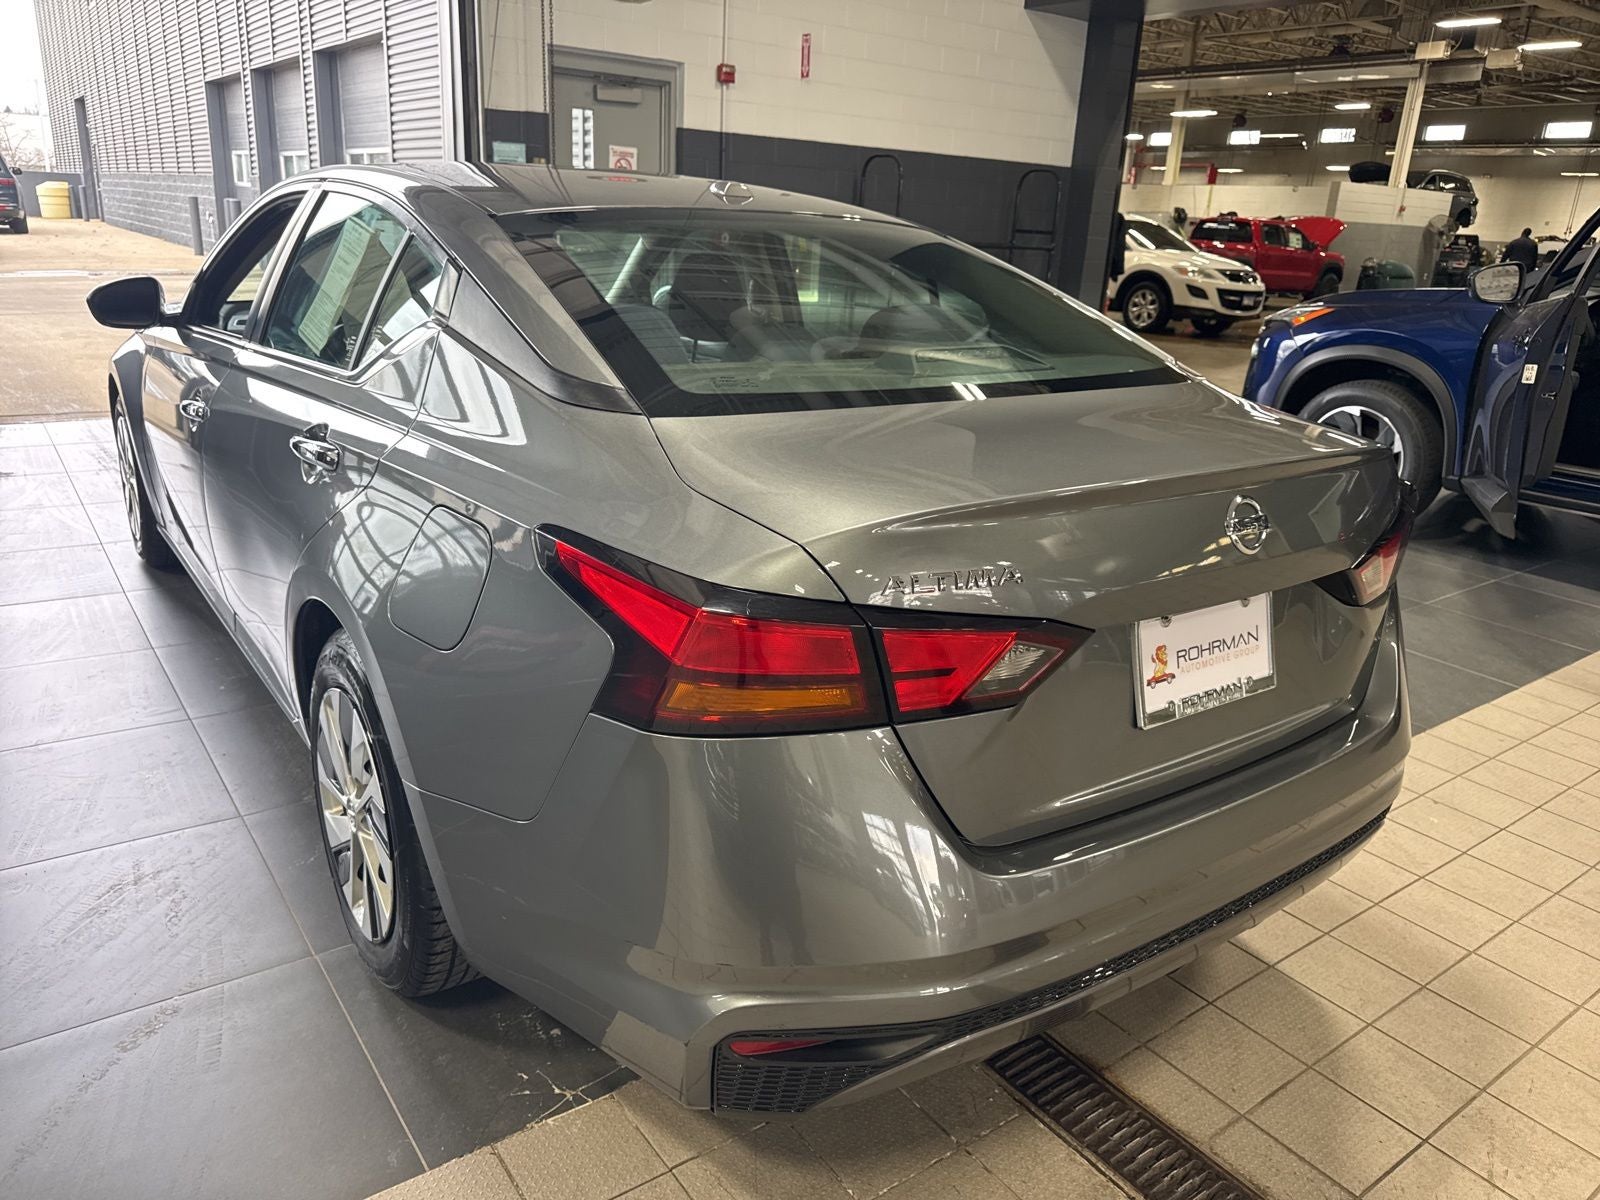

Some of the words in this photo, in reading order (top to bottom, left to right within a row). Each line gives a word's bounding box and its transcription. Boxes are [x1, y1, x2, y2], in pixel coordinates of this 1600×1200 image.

[881, 567, 1023, 596] ALTIMA
[1176, 624, 1259, 670] ROHRMAN
[1180, 653, 1231, 674] AUTOMOTIVE
[1233, 644, 1260, 660] GROUP
